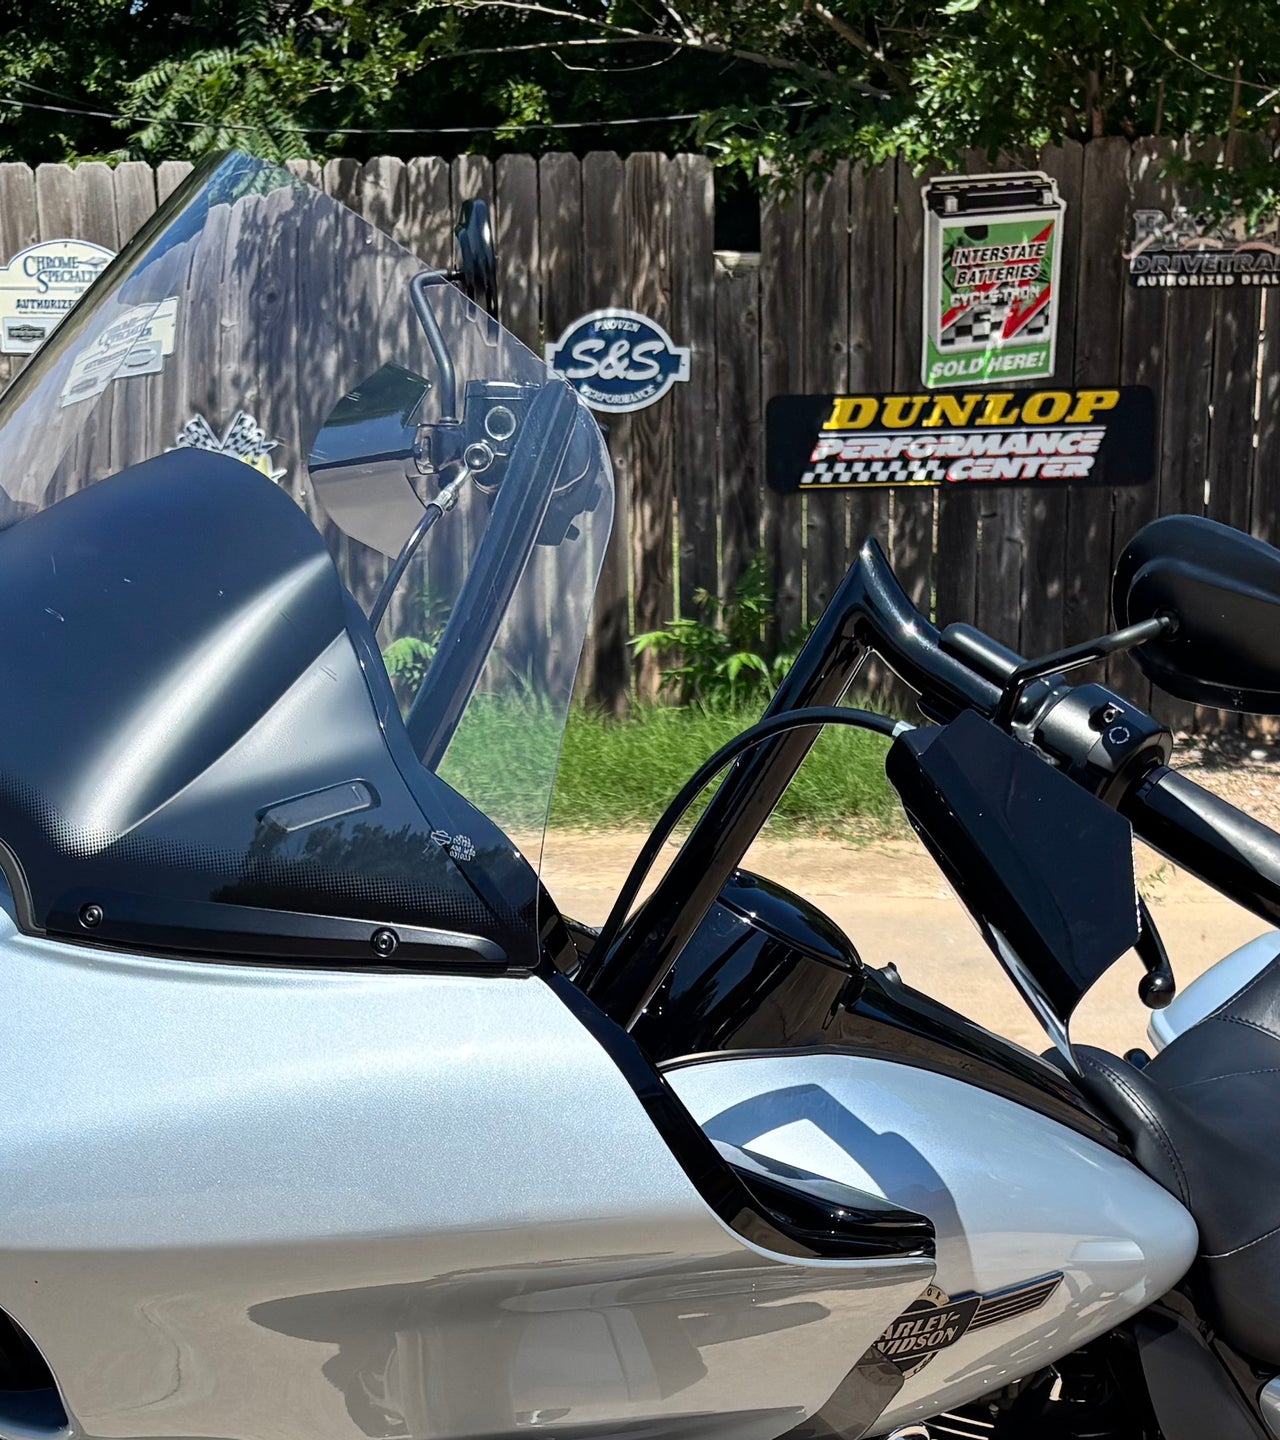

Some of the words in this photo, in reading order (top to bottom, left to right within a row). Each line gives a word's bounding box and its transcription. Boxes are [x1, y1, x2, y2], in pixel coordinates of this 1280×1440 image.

[23, 255, 80, 277] CHROME
[951, 242, 1047, 266] INTERSTATE
[954, 264, 1040, 287] BATTERIES
[1137, 274, 1234, 287] AUTHORIZED
[594, 319, 642, 333] PROVEN
[566, 339, 665, 380] S&S
[931, 355, 984, 379] SOLD
[987, 351, 1047, 373] HERE!
[579, 384, 656, 404] PERFORMANCE
[822, 390, 1120, 430] DUNLOP
[811, 431, 1106, 462] PERFORMANCE
[947, 456, 1096, 482] CENTER
[880, 1311, 961, 1340] ARLEY-
[876, 1326, 959, 1355] VIDSON
